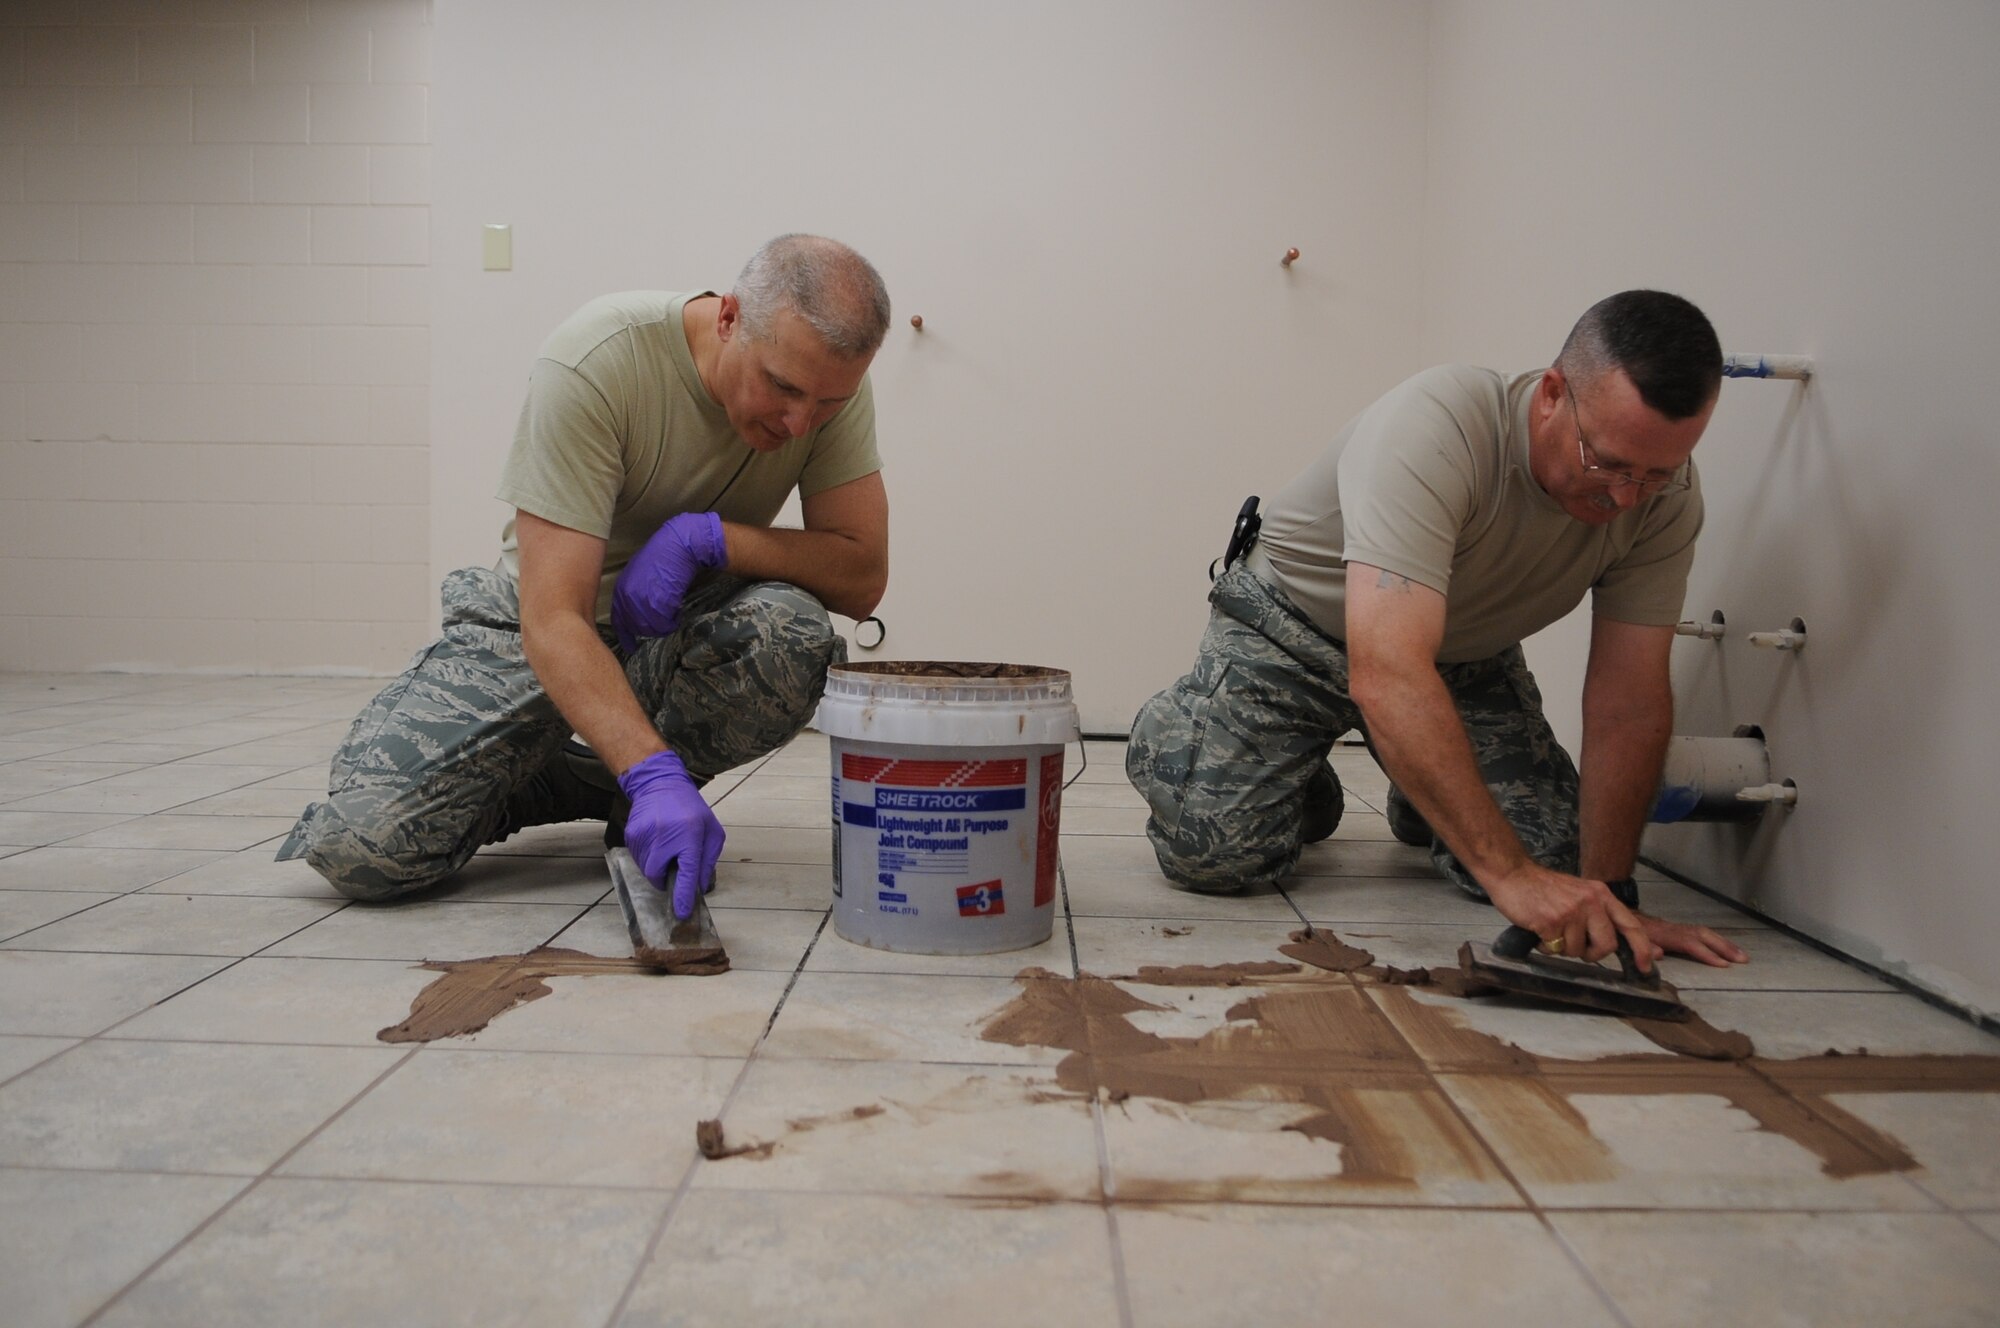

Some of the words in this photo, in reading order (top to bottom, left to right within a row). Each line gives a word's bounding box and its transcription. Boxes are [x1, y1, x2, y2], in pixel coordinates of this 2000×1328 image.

[877, 792, 978, 808] SHEETROCK
[878, 815, 943, 835] Lightweight
[963, 818, 1009, 835] Purpose
[878, 833, 904, 849] Joint
[907, 835, 968, 853] Compound
[975, 885, 992, 913] 3
